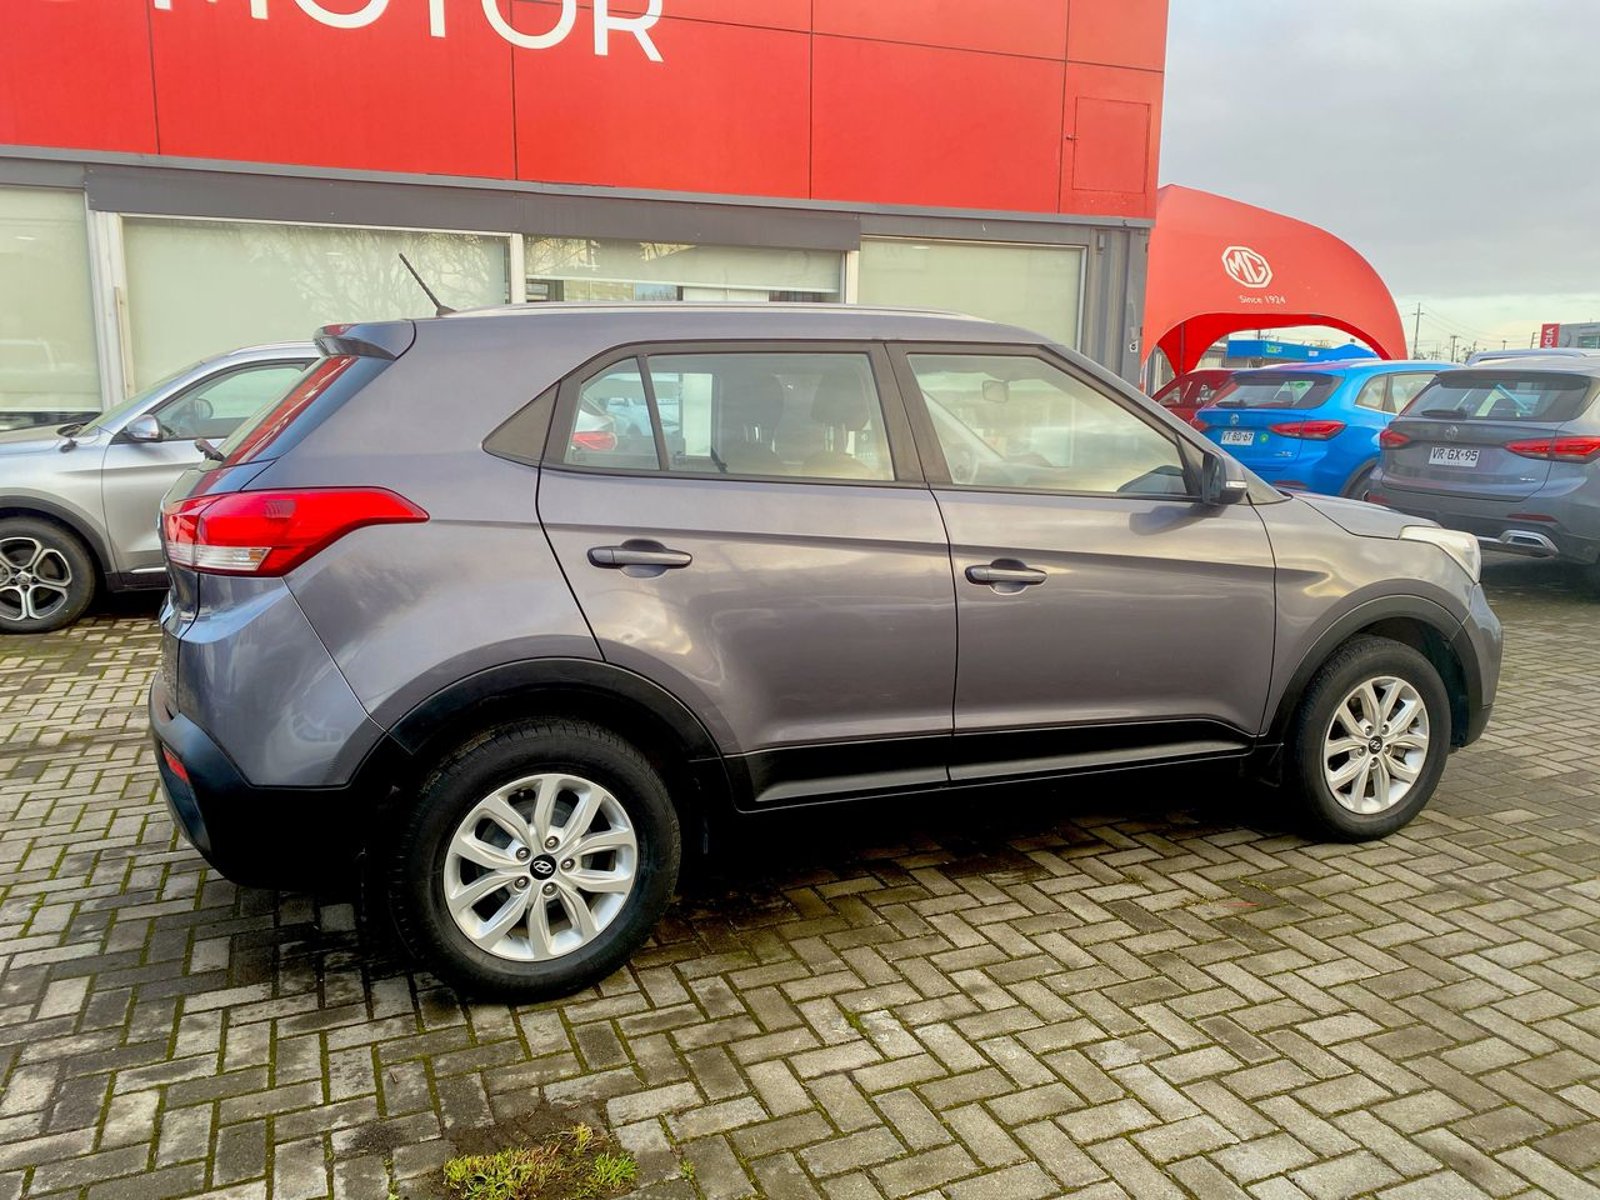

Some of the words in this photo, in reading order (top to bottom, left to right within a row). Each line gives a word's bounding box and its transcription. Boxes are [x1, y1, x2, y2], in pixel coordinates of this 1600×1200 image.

[1226, 249, 1268, 284] MG
[1239, 294, 1263, 304] Since
[1264, 294, 1286, 305] 1924
